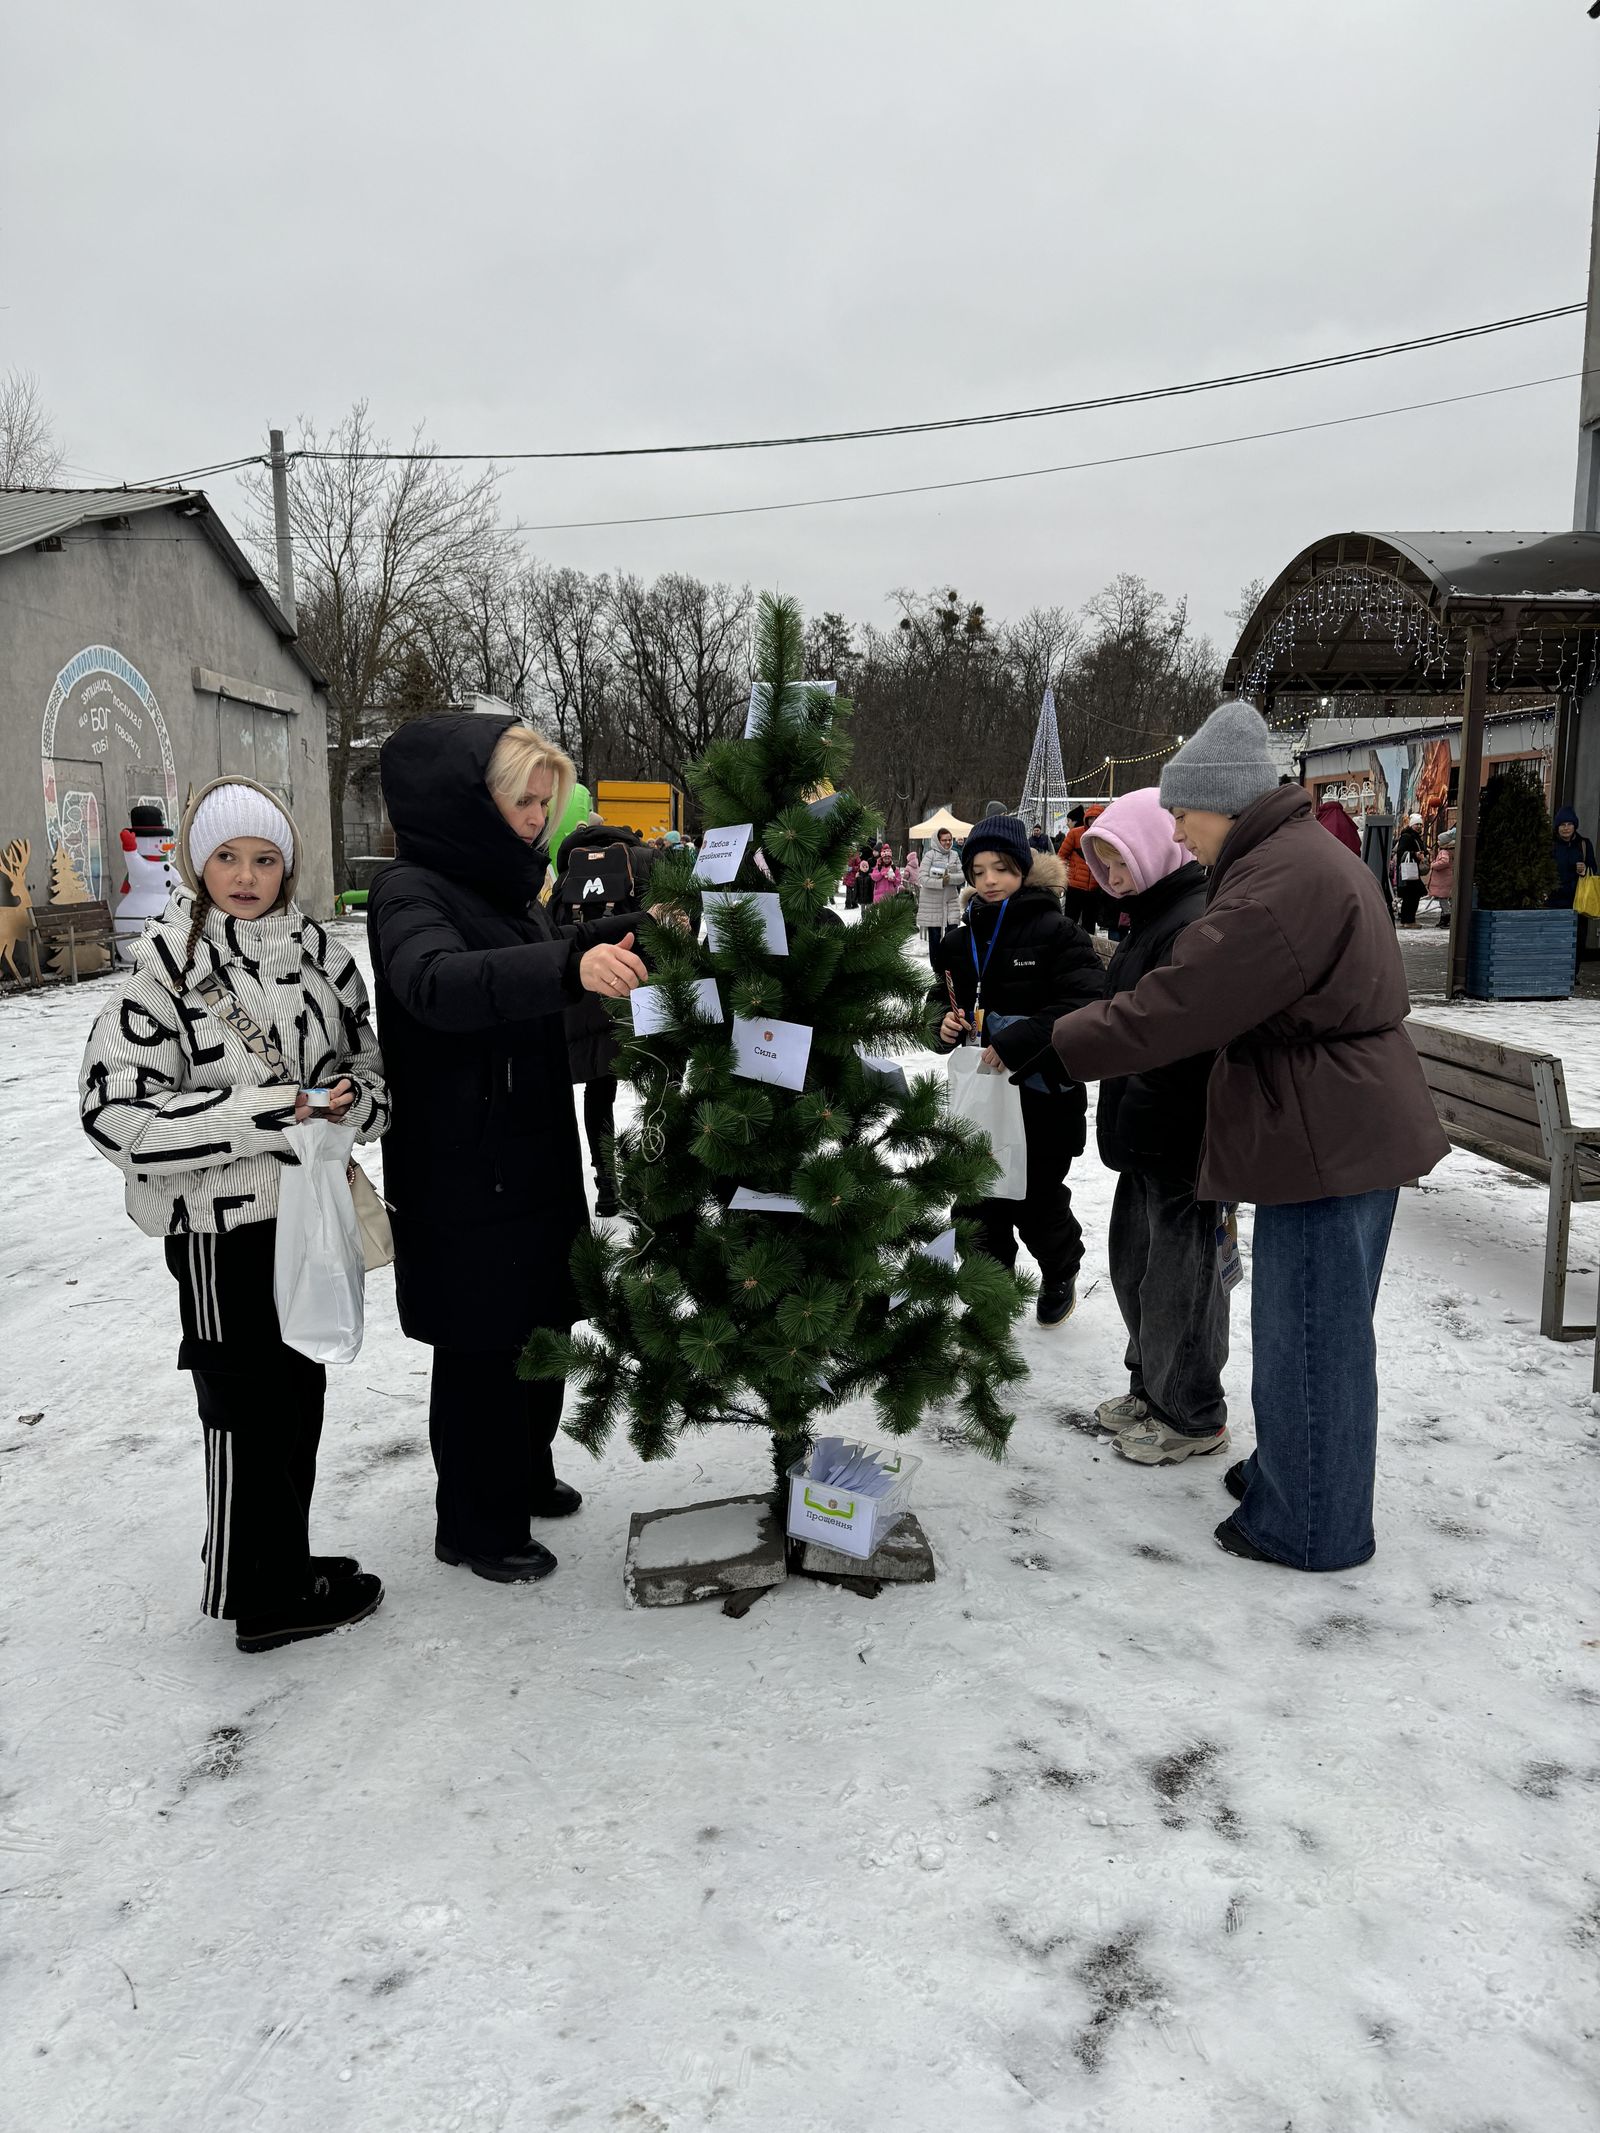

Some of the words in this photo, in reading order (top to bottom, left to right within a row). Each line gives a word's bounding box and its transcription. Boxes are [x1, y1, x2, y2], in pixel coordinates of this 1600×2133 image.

[90, 706, 111, 731] БОГ
[709, 840, 730, 849] Любов
[754, 1046, 777, 1059] Сила
[806, 1510, 853, 1531] Прощення
